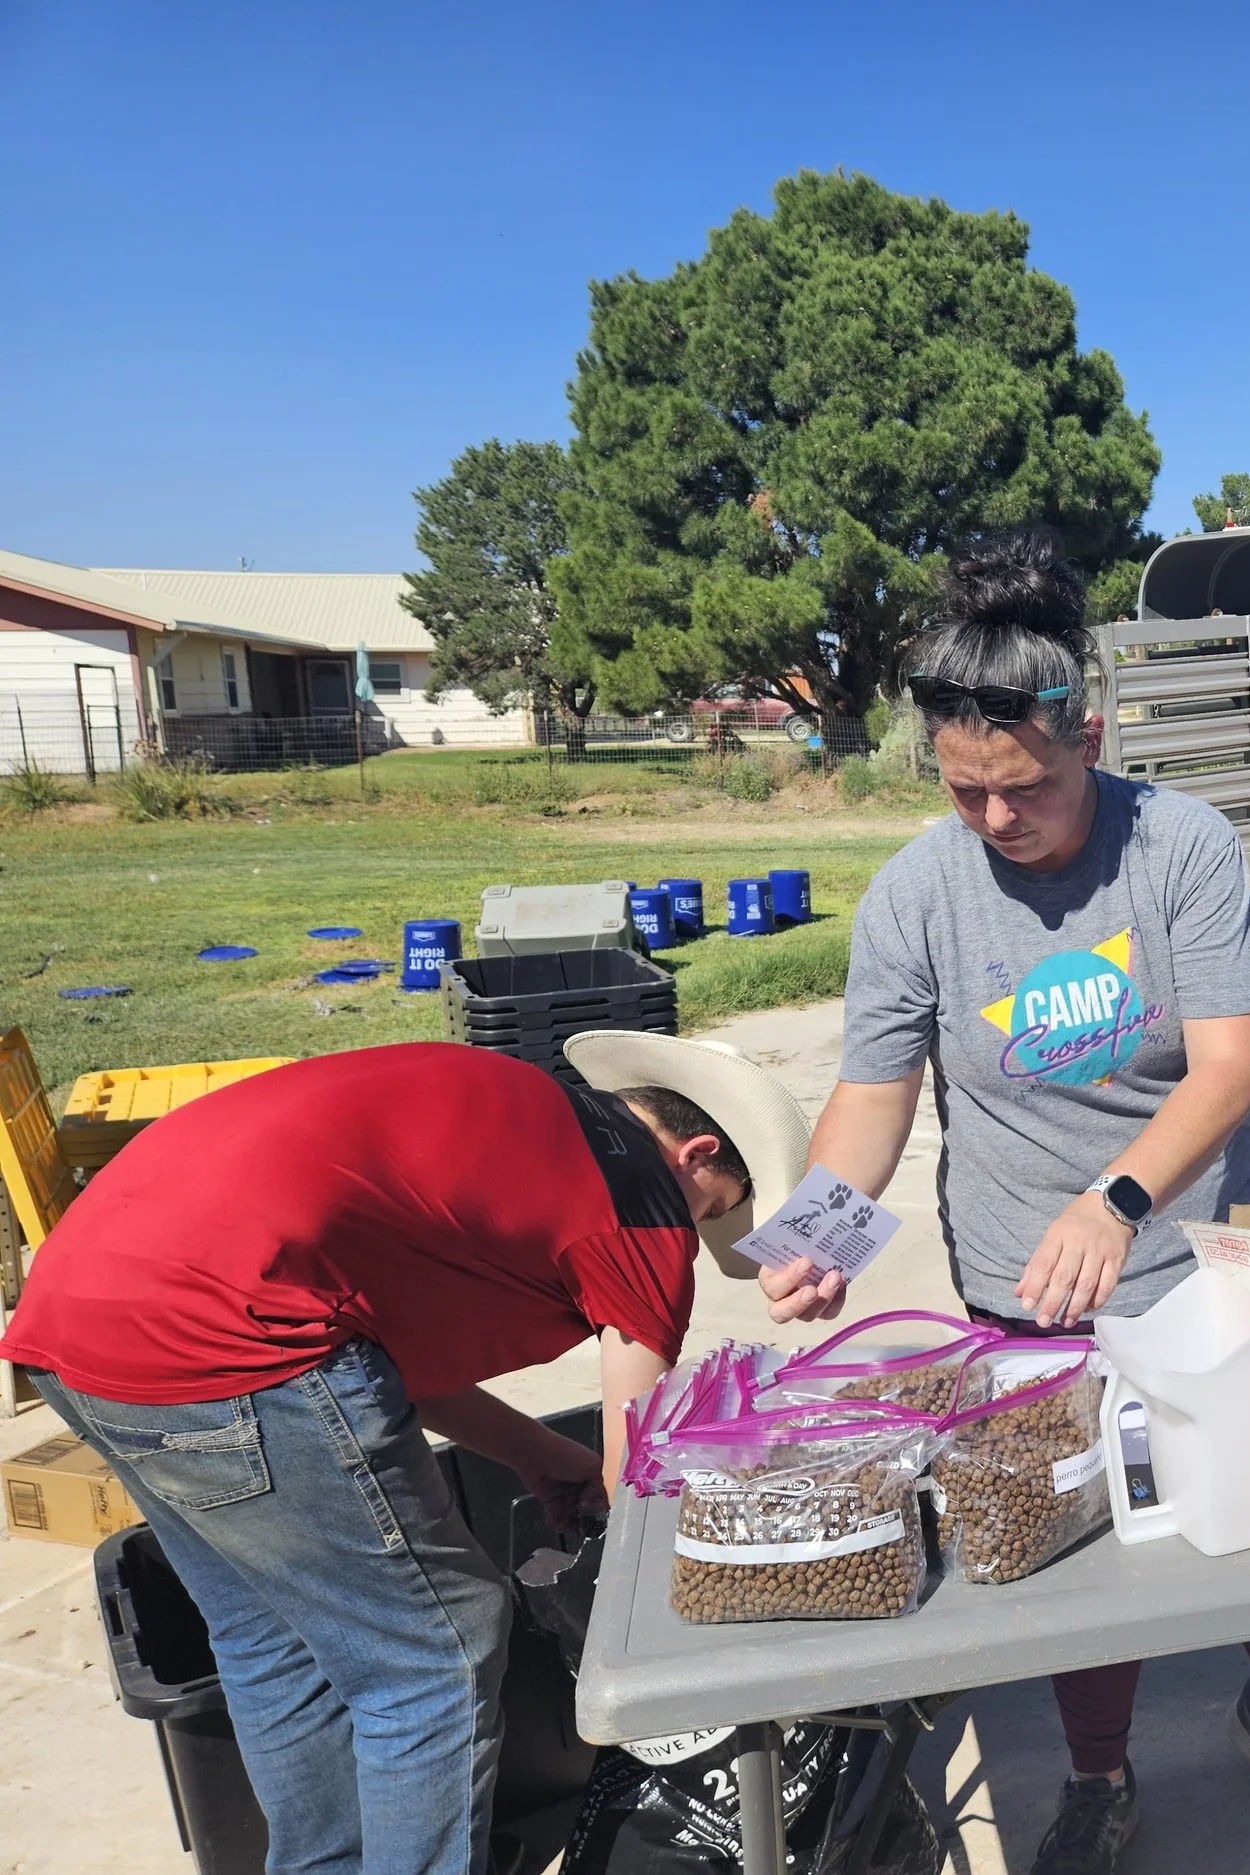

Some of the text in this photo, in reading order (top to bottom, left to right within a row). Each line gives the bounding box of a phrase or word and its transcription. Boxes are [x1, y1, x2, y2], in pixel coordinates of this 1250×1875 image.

[632, 914, 657, 923] RIGH
[409, 947, 445, 958] RIGHT
[409, 959, 423, 970] IT
[1025, 973, 1120, 1034] CAMP
[1000, 986, 1165, 1079] Crossfire
[1056, 1469, 1078, 1485] perro
[793, 1482, 808, 1490] DAY
[730, 1493, 745, 1501] MAY
[764, 1494, 777, 1503] JUL
[830, 1489, 845, 1497] NOV
[813, 1501, 820, 1509] 7
[832, 1500, 839, 1509] 8
[849, 1502, 855, 1510] 9
[754, 1517, 763, 1525] 15
[773, 1517, 782, 1525] 16
[811, 1514, 821, 1523] 18
[830, 1514, 840, 1522] 19
[846, 1514, 858, 1523] 20
[752, 1531, 764, 1539] 26
[771, 1530, 782, 1539] 27
[790, 1529, 802, 1537] 28
[809, 1528, 819, 1537] 29
[828, 1528, 839, 1536] 30
